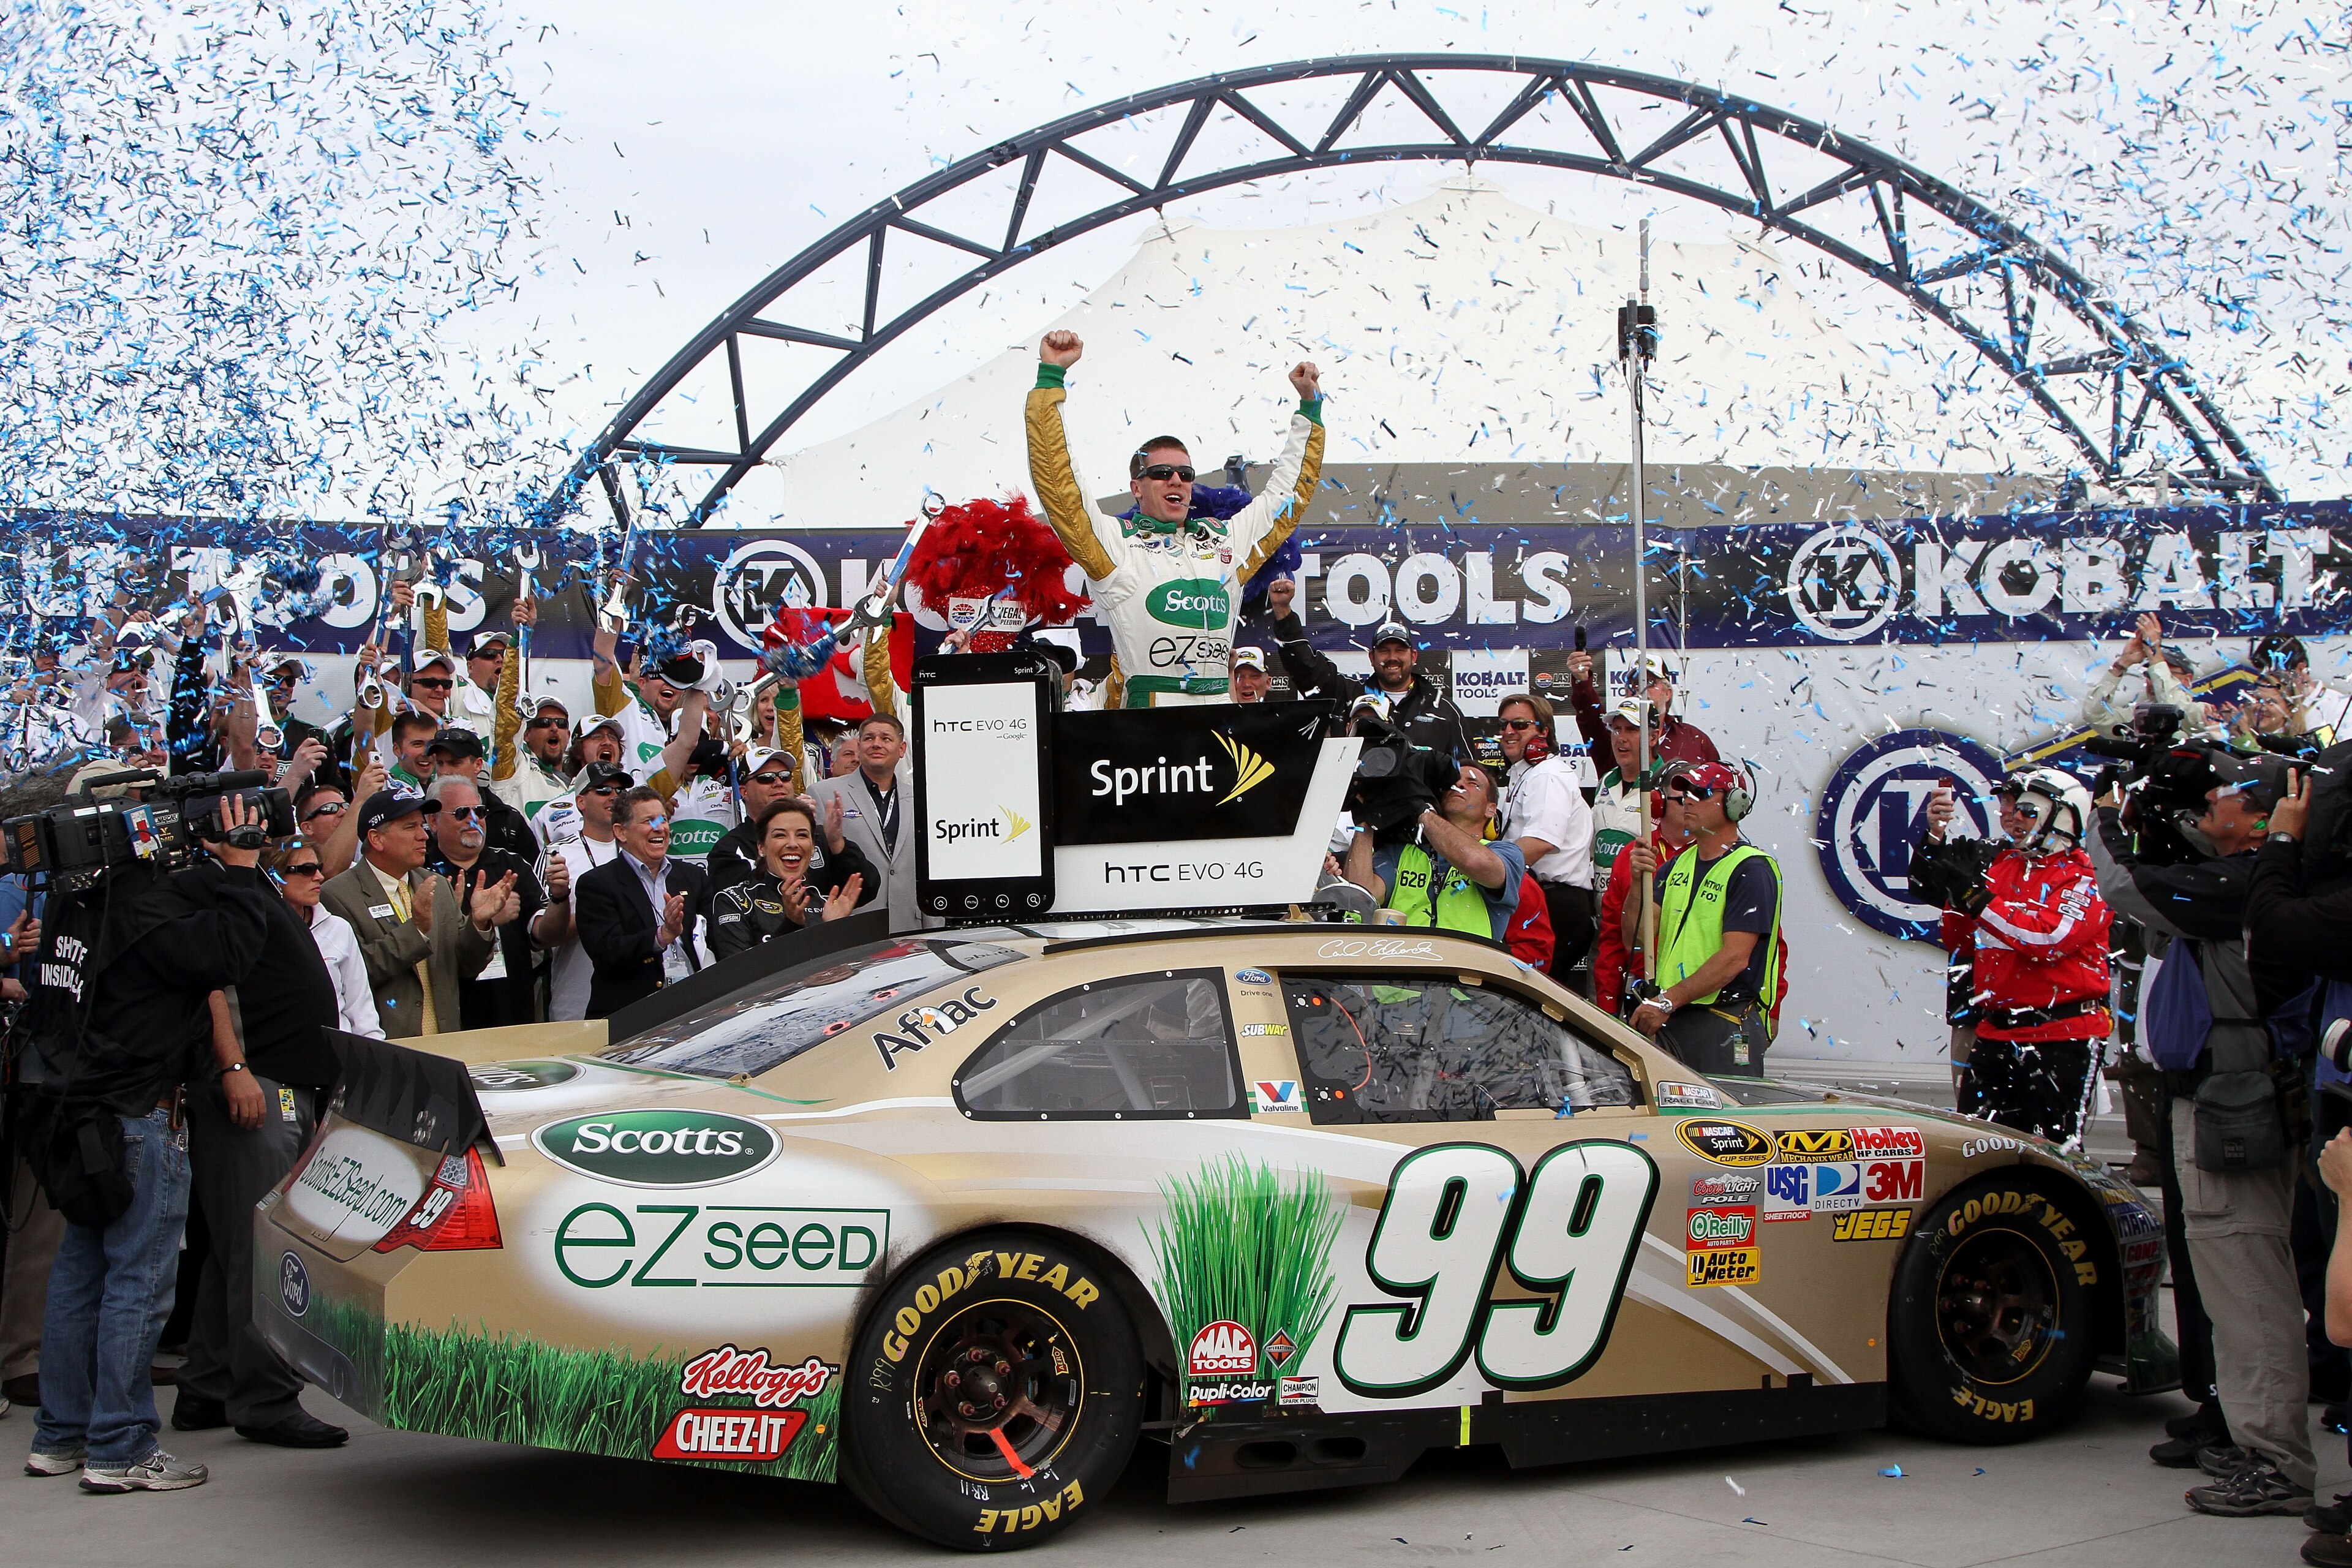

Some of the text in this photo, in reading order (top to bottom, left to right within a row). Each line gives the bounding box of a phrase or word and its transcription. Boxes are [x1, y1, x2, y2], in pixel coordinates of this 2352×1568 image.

[1915, 528, 2331, 616] KOBALT
[1290, 551, 1573, 627] TOOLS
[1164, 590, 1226, 613] Scotts
[1014, 666, 1033, 675] Sprint
[1456, 672, 1526, 687] KOBALT
[1457, 688, 1498, 698] TOOLS
[976, 719, 1005, 731] EVO
[1009, 718, 1027, 730] 4G
[1003, 733, 1025, 741] Google
[1091, 756, 1215, 807] Sprint
[935, 817, 999, 843] Sprint
[1178, 863, 1226, 881] EVO
[1234, 862, 1264, 879] 4G
[1400, 870, 1427, 888] 628
[1670, 872, 1689, 887] 624
[1243, 971, 1267, 983] Ford
[871, 985, 998, 1072] Aflac
[1240, 1023, 1288, 1038] SUBWAY
[1681, 1085, 1711, 1099] NASCAR
[1663, 1096, 1718, 1108] RACE CAR
[571, 1122, 744, 1158] Scotts
[1702, 1126, 1735, 1137] NASCAR
[1711, 1137, 1744, 1150] Sprint
[1852, 1128, 1924, 1155] Holley
[1781, 1152, 1855, 1163] MECHANIX WEAR
[1874, 1148, 1912, 1157] CARBS
[299, 1146, 409, 1230] ScottsEZSeed.com
[1692, 1178, 1760, 1196] Coors LIGHT
[1766, 1166, 1808, 1205] USG
[1866, 1161, 1923, 1202] 3M
[410, 1187, 454, 1229] 99
[1701, 1194, 1750, 1204] POLE
[1815, 1198, 1860, 1210] DIRECTV
[1763, 1211, 1808, 1221] SHEETROCK
[1835, 1210, 1912, 1240] JEGS
[1691, 1213, 1753, 1240] O'Reilly
[1706, 1252, 1747, 1267] Auto
[1333, 1138, 1660, 1400] 99
[1705, 1265, 1755, 1281] Meter
[283, 1258, 304, 1306] Ford
[1192, 1325, 1253, 1359] MAC
[1192, 1358, 1252, 1370] TOOLS
[684, 1349, 827, 1405] Kellogg's
[1283, 1383, 1316, 1392] CHAMPION
[1953, 1385, 2034, 1423] EAGLE
[676, 1412, 786, 1453] CHEEZ-IT
[973, 1479, 1085, 1533] EAGLE
